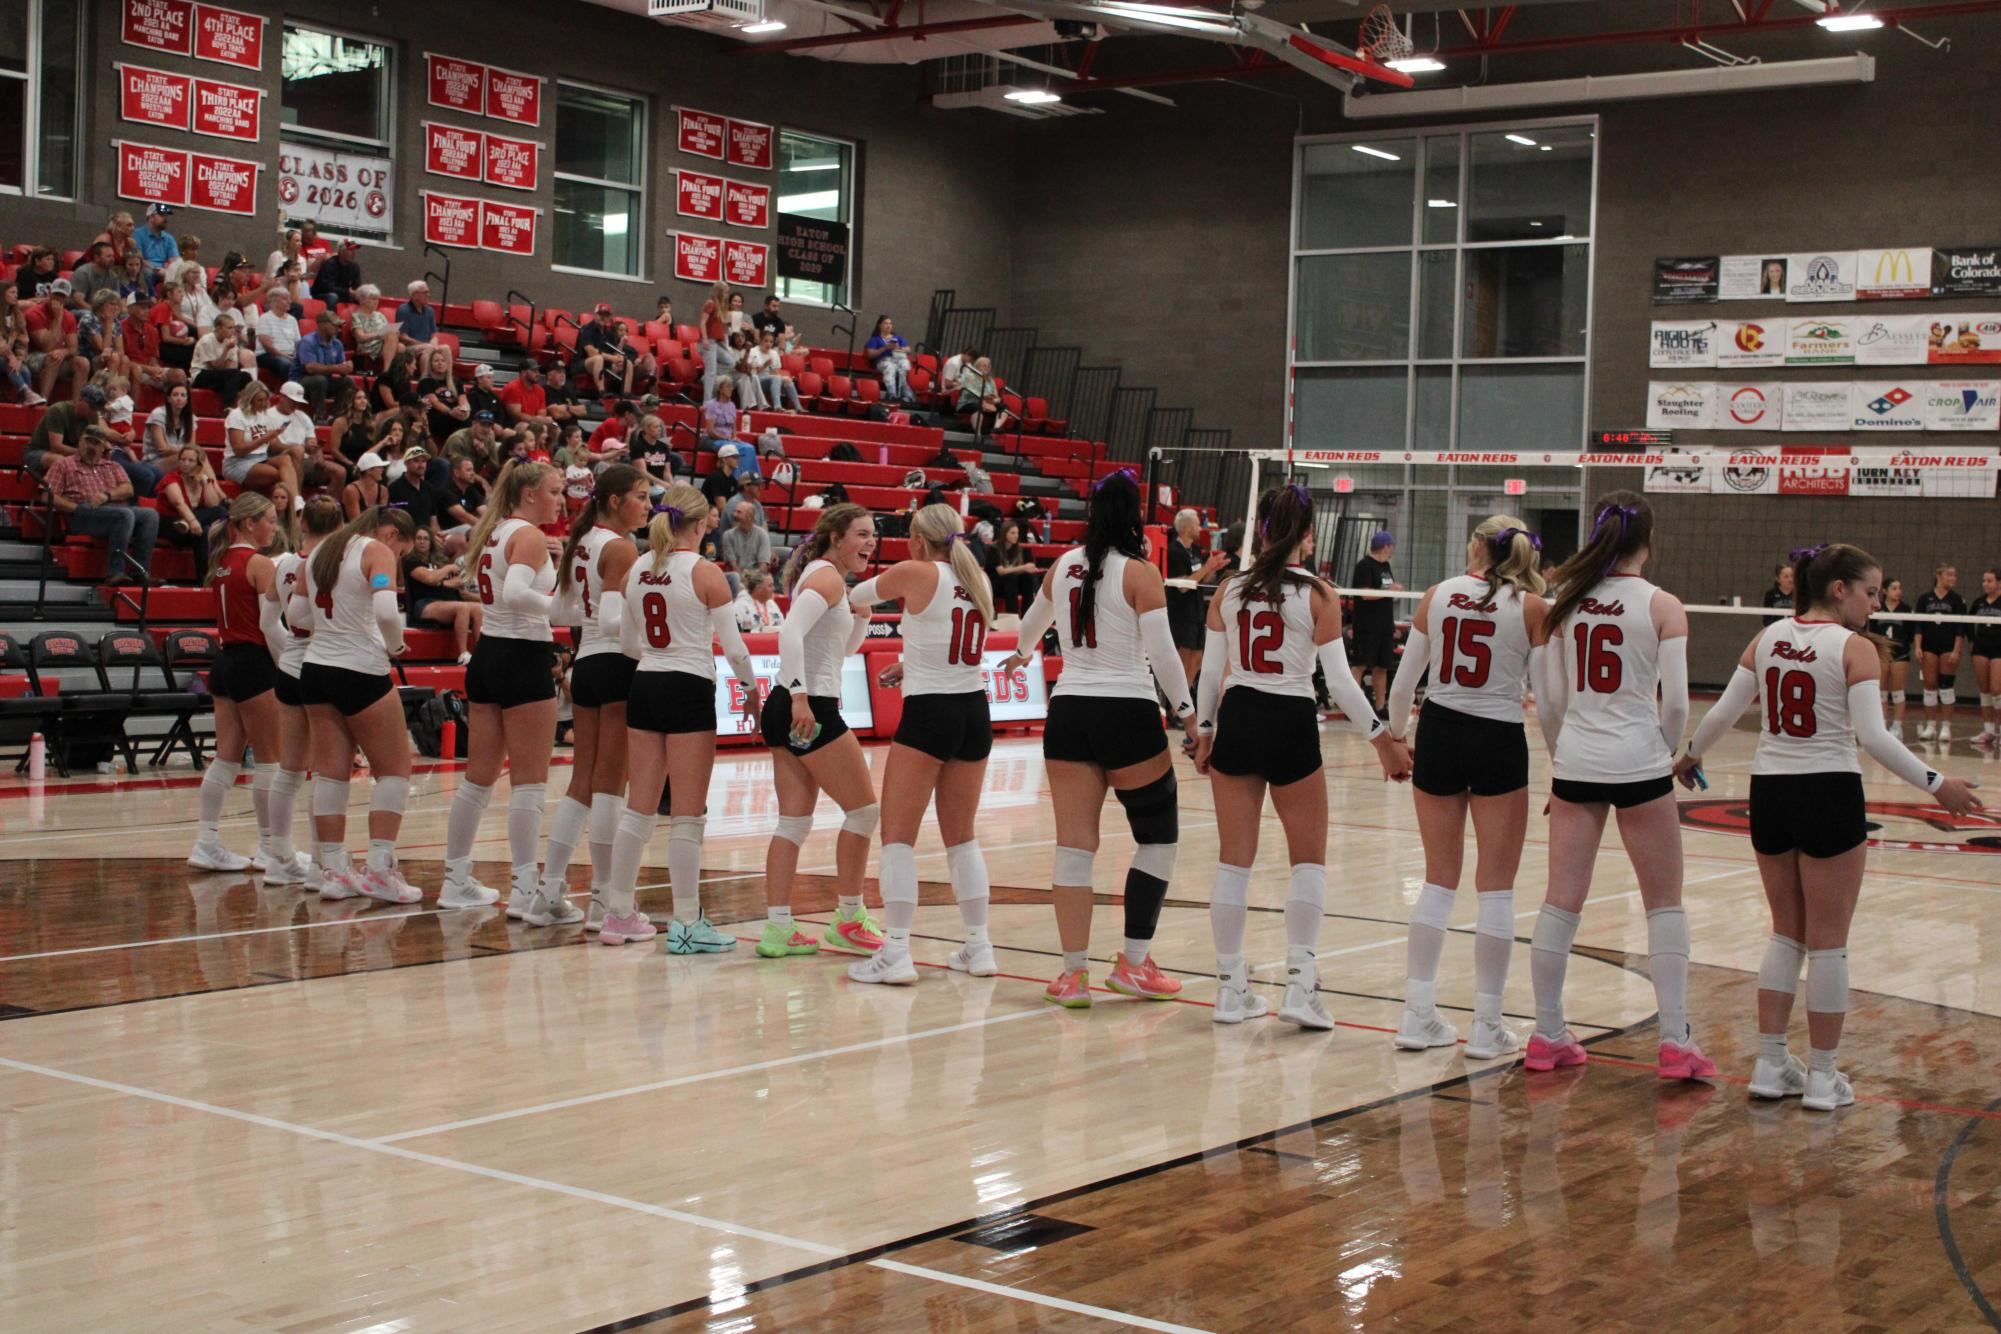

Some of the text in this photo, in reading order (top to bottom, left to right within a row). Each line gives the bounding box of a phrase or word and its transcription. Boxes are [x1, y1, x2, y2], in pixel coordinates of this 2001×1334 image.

[131, 0, 184, 27] 2ND PLACE
[220, 13, 241, 25] STATE
[204, 16, 255, 42] 4TH PLACE
[146, 73, 168, 84] STATE
[436, 65, 479, 89] CHAMPIONS
[130, 75, 183, 101] CHAMPIONS
[217, 87, 239, 98] STATE
[492, 78, 534, 101] CHAMPIONS
[201, 89, 255, 114] THIRD PLACE
[683, 116, 704, 130] FINAL
[703, 123, 722, 137] FOUR
[433, 132, 477, 156] FINAL FOUR
[732, 128, 768, 146] CHAMPIONS
[143, 150, 166, 161] STATE
[490, 144, 530, 166] 3RD PLACE
[128, 153, 181, 178] CHAMPIONS
[198, 163, 250, 188] CHAMPIONS
[214, 161, 236, 172] STATE
[279, 155, 387, 189] CLASS OF
[306, 184, 358, 210] 2026
[681, 179, 721, 198] FINAL FOUR
[728, 188, 749, 203] FINAL
[748, 195, 766, 207] FOUR
[430, 201, 474, 223] CHAMPIONS
[486, 211, 531, 231] FINAL FOUR
[795, 225, 829, 240] EATON
[680, 241, 717, 260] CHAMPIONS
[727, 247, 746, 262] FINAL
[777, 235, 848, 255] HIGH SCHOOL
[788, 248, 835, 264] CLASS OF
[1951, 252, 1996, 267] Bank of
[1792, 341, 1850, 350] Farmers
[1658, 399, 1705, 408] Slaughter
[1928, 397, 1997, 407] CROP AIR
[1662, 408, 1699, 417] Roofing
[1855, 418, 1921, 426] Domino's
[1304, 451, 1381, 462] EATON REDS
[1437, 452, 1518, 463] EATON REDS
[1578, 454, 1665, 464] EATON REDS
[1729, 455, 1821, 466] EATON REDS
[1890, 456, 1989, 467] EATON REDS
[1783, 478, 1845, 490] ARCHITECTS
[477, 553, 495, 605] 6
[219, 583, 229, 630] 1
[1447, 593, 1499, 614] Reds
[1577, 597, 1626, 617] Reds
[642, 592, 672, 649] 8
[947, 607, 989, 667] 10
[1237, 608, 1285, 675] 12
[1439, 616, 1497, 689] 15
[1574, 622, 1625, 694] 16
[1771, 640, 1818, 664] Reds
[1765, 666, 1818, 738] 18
